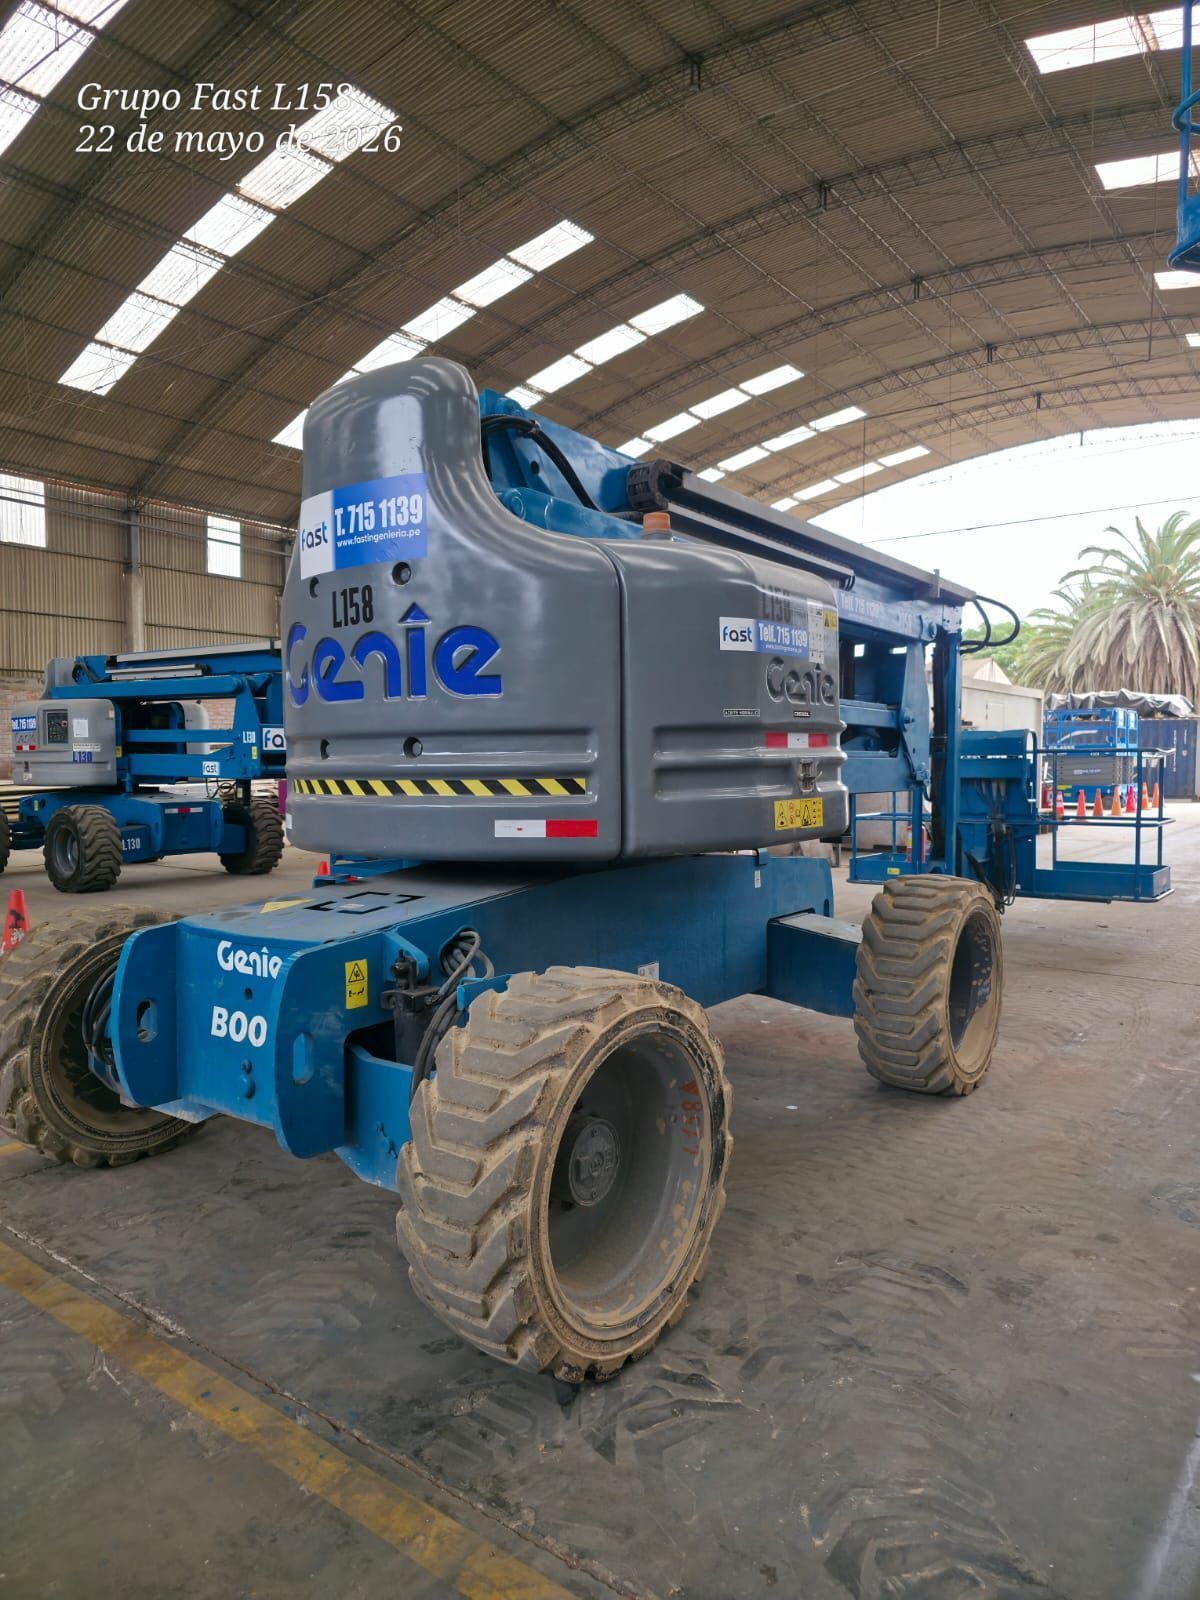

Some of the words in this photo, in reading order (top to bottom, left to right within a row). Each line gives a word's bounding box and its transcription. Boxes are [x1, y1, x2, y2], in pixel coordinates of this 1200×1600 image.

[335, 507, 345, 537] T.
[347, 501, 375, 534] 715
[379, 494, 423, 528] 1139
[302, 520, 328, 552] fast
[332, 584, 374, 629] L158
[722, 625, 753, 643] fast
[776, 625, 790, 645] 715
[285, 601, 503, 708] Genie
[765, 656, 835, 707] Genie
[264, 729, 285, 748] fa
[73, 751, 93, 764] L130
[121, 838, 141, 851] L130
[216, 939, 283, 980] Genie
